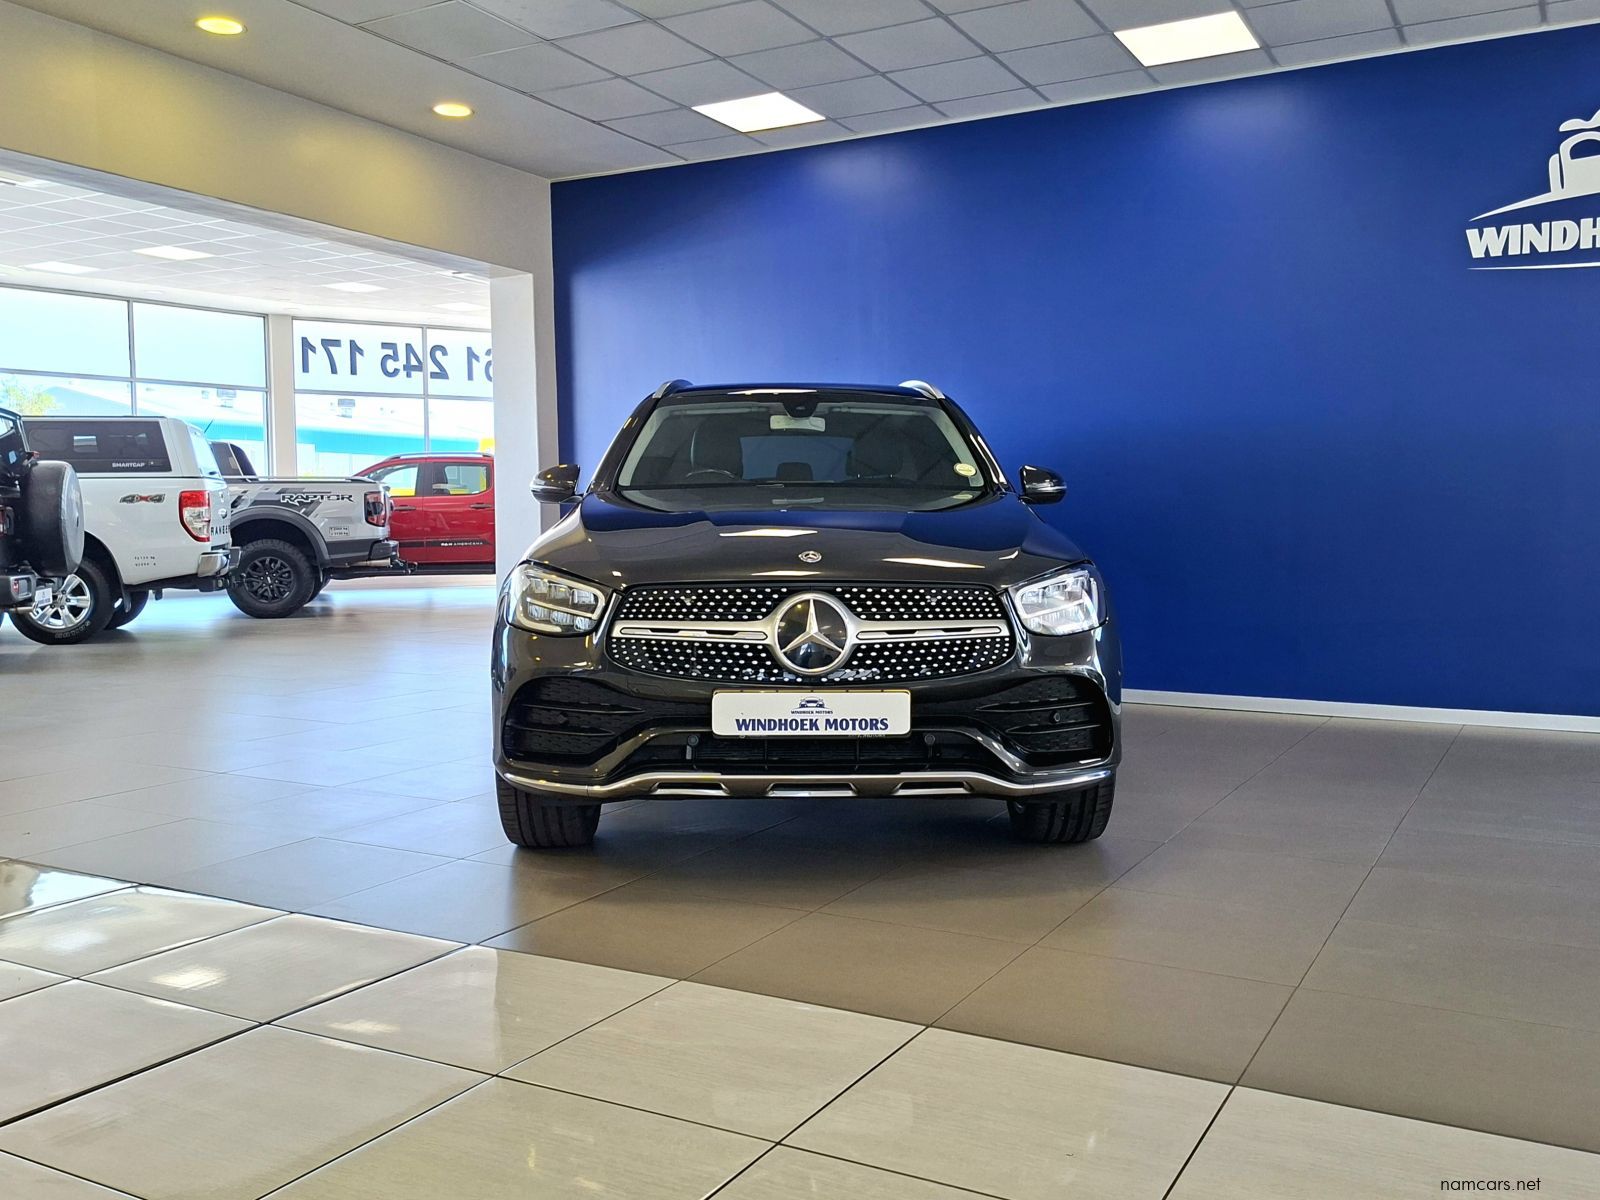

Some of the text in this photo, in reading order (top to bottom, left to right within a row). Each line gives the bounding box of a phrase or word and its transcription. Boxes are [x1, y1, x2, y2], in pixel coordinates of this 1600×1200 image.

[280, 493, 354, 506] RAPTOR
[735, 717, 889, 732] WINDHOEK MOTORS
